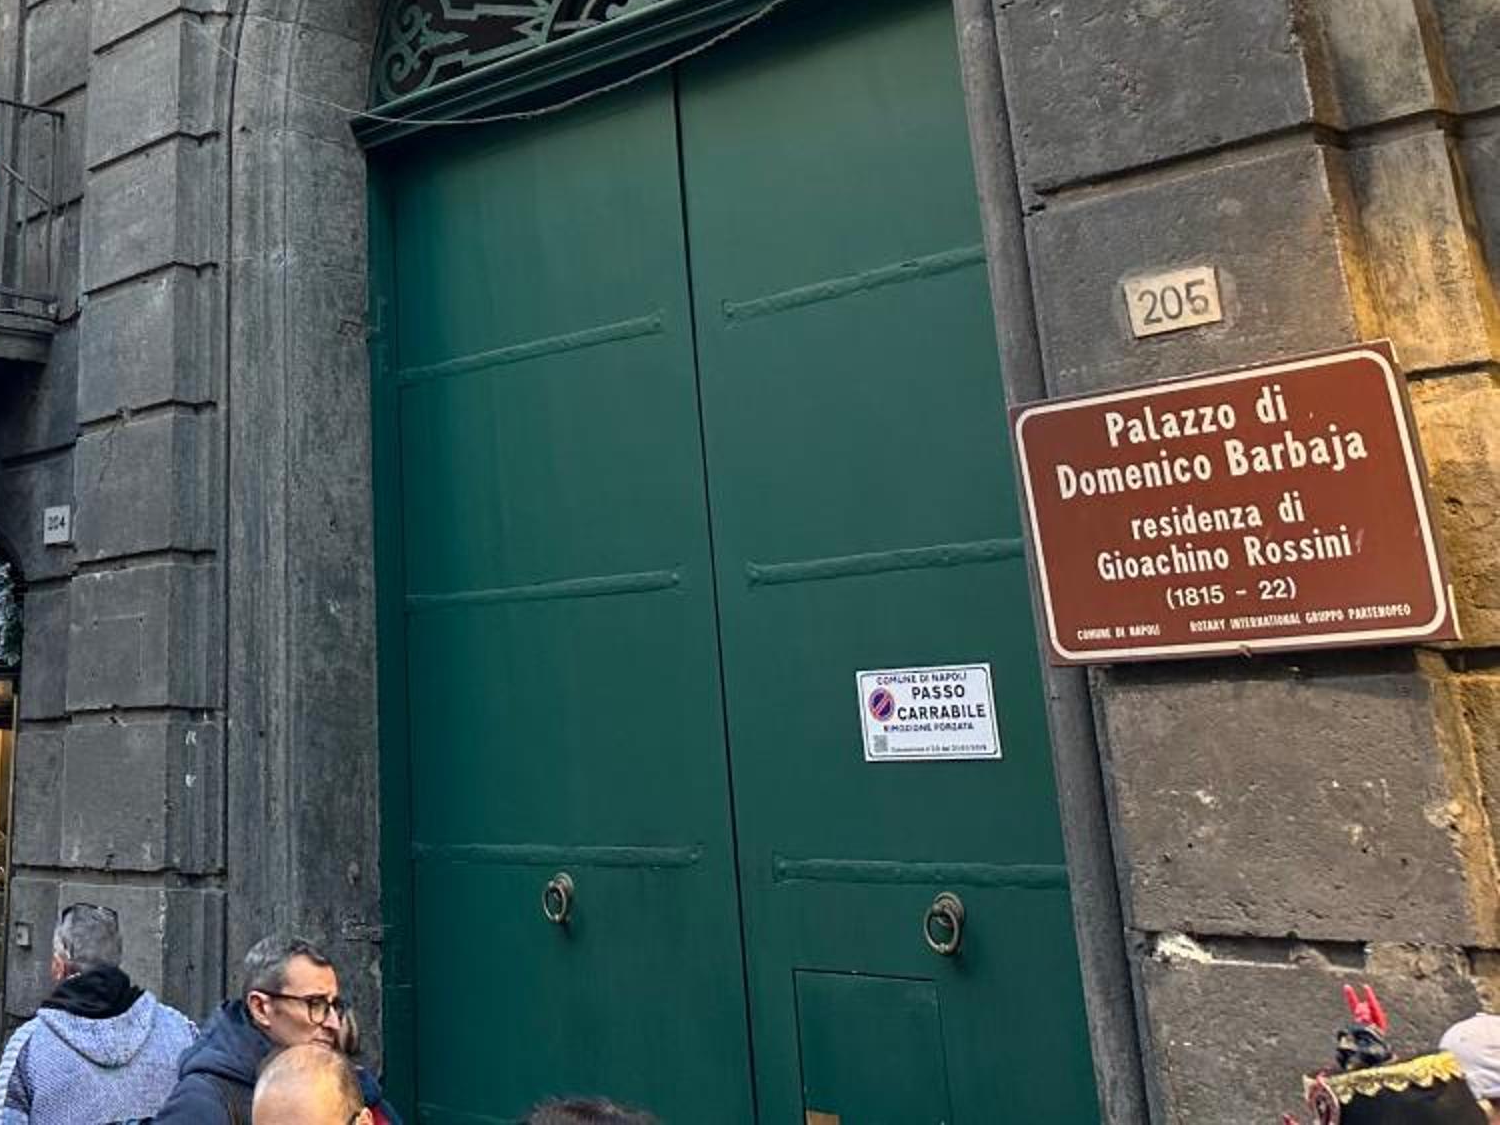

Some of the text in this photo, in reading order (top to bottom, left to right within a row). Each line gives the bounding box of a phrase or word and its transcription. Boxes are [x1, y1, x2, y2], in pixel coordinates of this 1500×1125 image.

[1137, 278, 1209, 326] 205
[1105, 384, 1288, 448] Palazzo di
[1056, 424, 1368, 500] Domenico Barbaja
[1131, 490, 1305, 540] residenza di
[1097, 525, 1352, 581] Gioachino Rossini
[1166, 584, 1225, 609] (1815
[1258, 577, 1296, 600] 22)
[1077, 624, 1160, 641] COMUNE DI NAPOLI
[1190, 603, 1411, 632] ROTARY INTERNATIONAL GRUPPO PARTENOPEO
[876, 671, 966, 685] COMUNE DI NAPOLI
[911, 684, 965, 700] PASSO
[897, 704, 987, 721] CARRABILE
